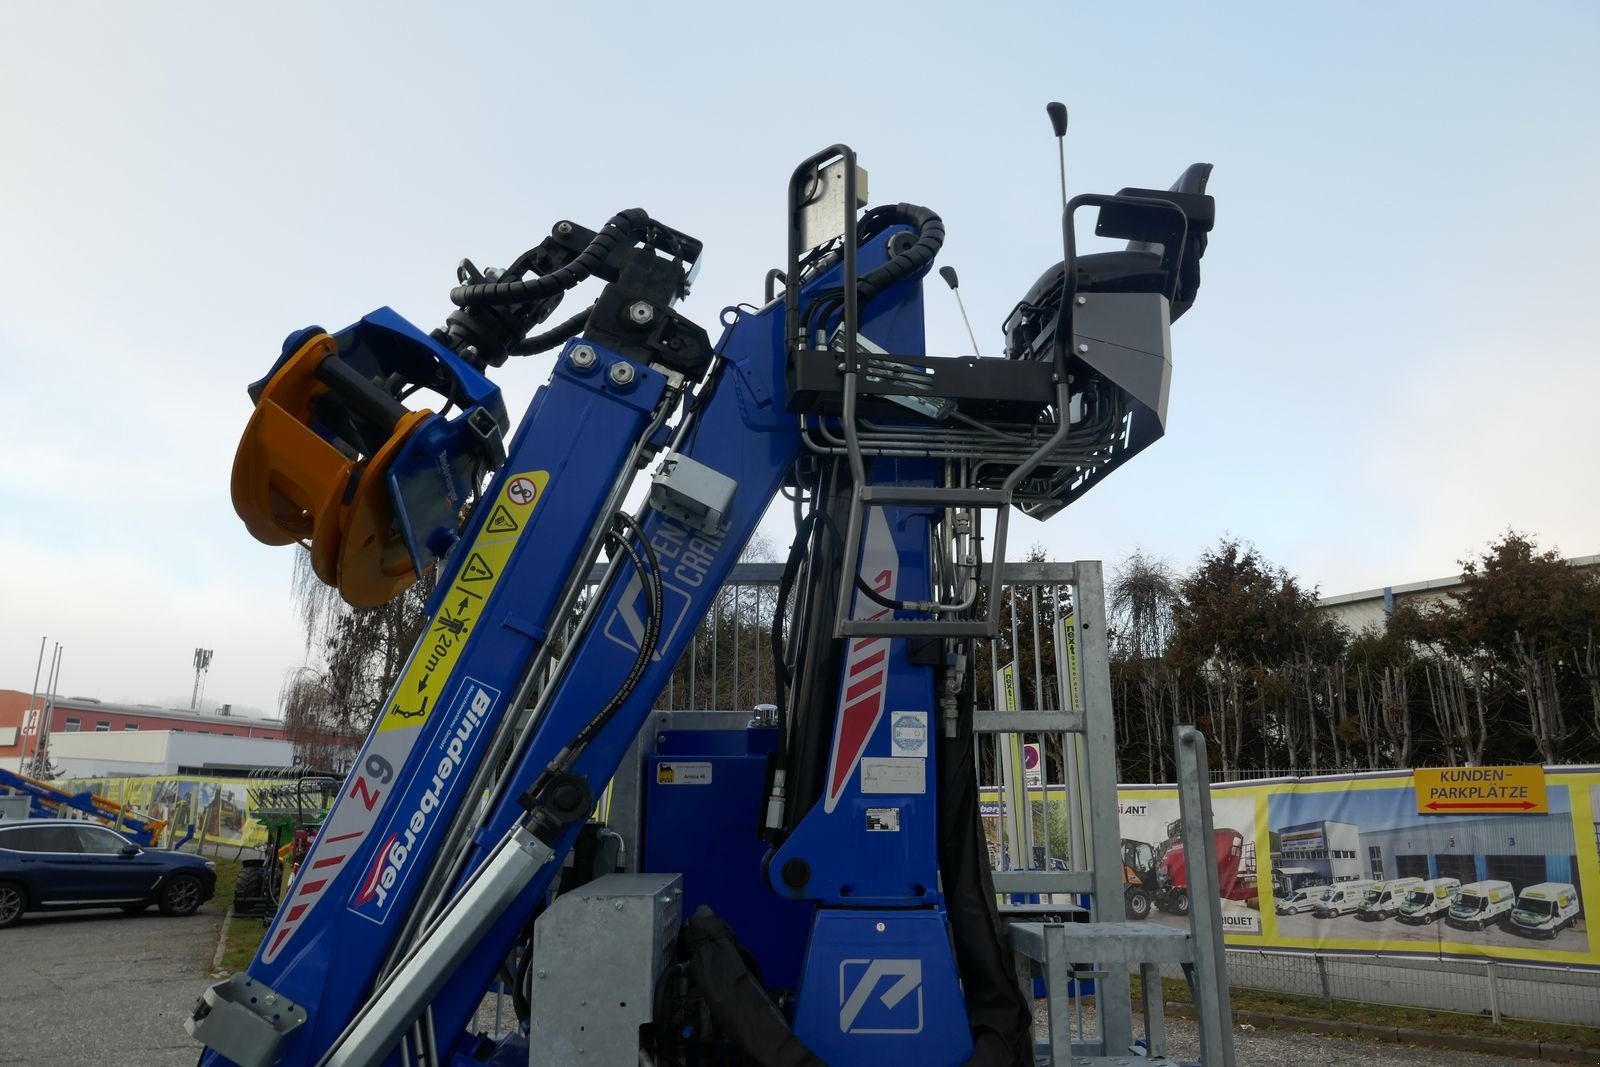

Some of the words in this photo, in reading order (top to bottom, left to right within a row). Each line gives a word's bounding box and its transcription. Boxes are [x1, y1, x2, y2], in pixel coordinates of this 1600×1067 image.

[642, 517, 689, 572] PEN
[425, 635, 452, 671] 20m
[1067, 626, 1076, 655] next
[1430, 782, 1528, 799] PARKPLÄTZE
[1440, 769, 1512, 782] KUNDEN-
[376, 687, 492, 908] Binderberger
